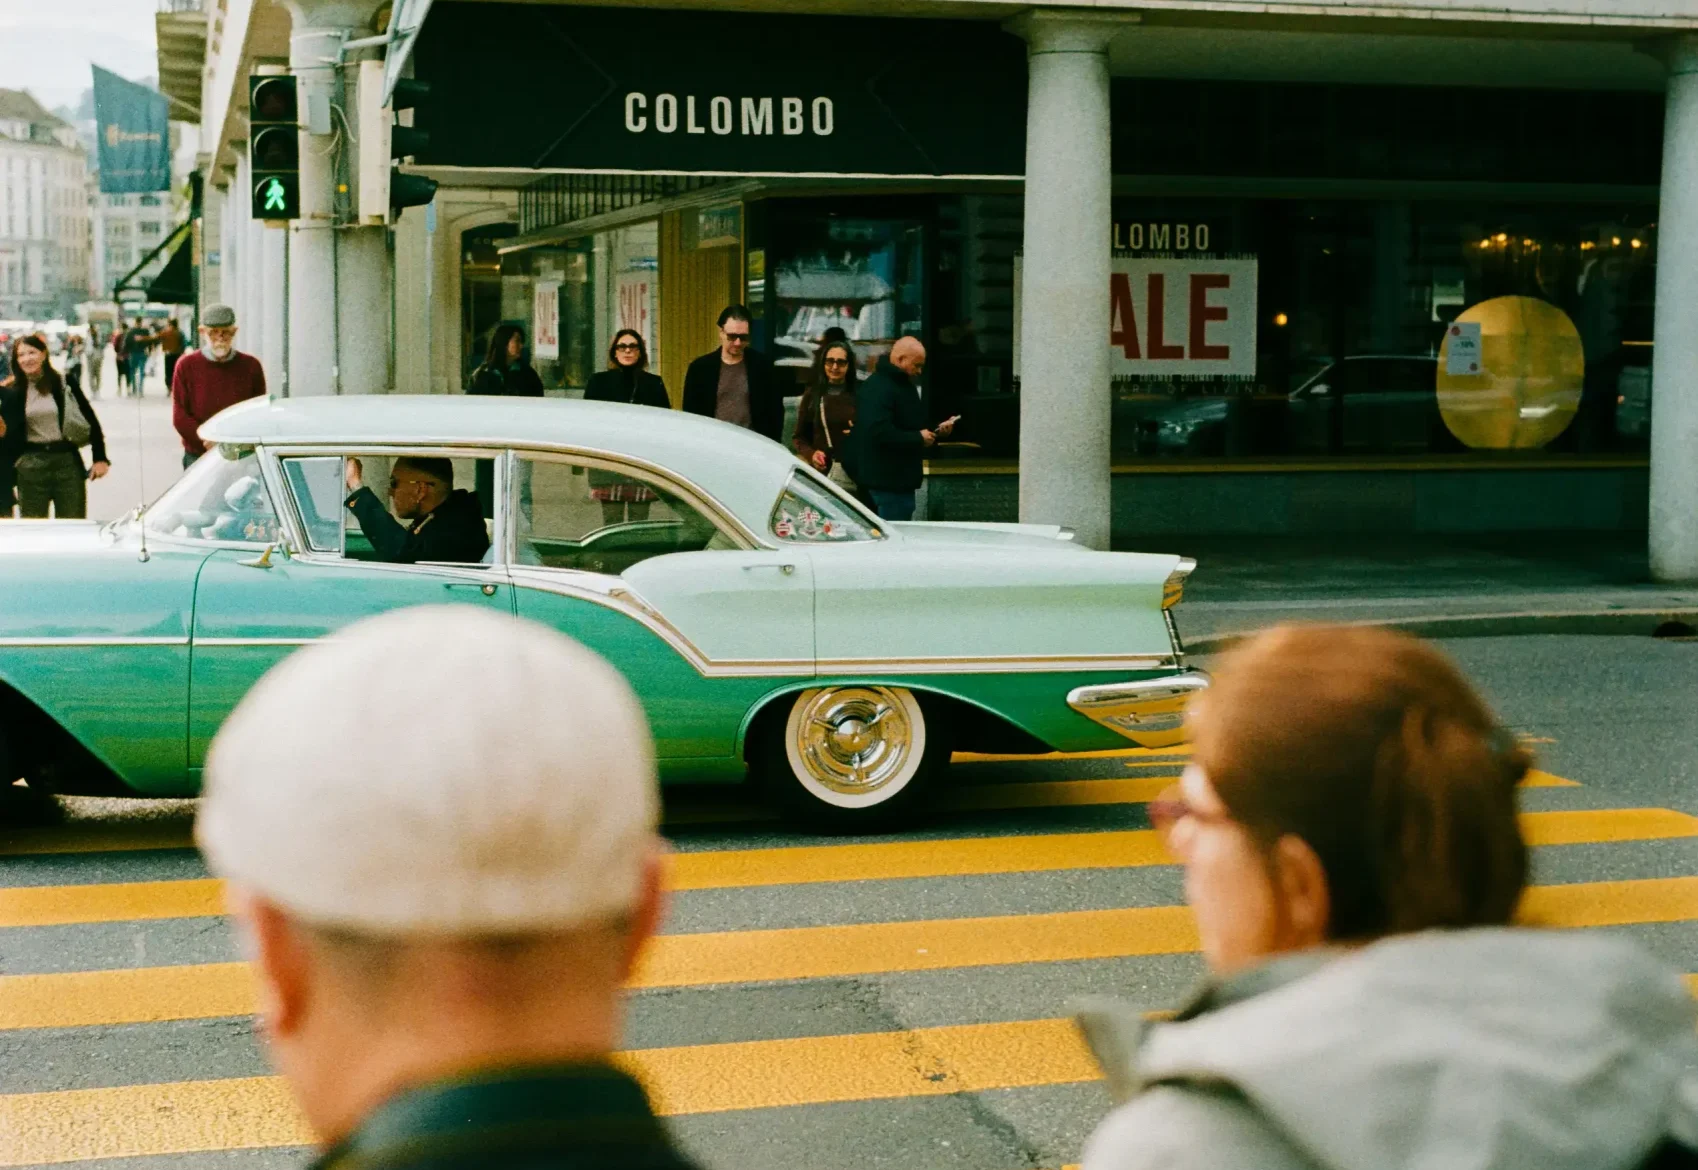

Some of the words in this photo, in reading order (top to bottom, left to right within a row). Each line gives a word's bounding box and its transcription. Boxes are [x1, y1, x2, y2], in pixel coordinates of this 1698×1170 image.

[625, 92, 834, 136] COLOMBO
[1113, 223, 1209, 250] LOMBO
[1110, 273, 1230, 359] ALE
[1119, 384, 1151, 393] ART
[1167, 384, 1188, 394] OF
[1202, 385, 1268, 394] LIVING
